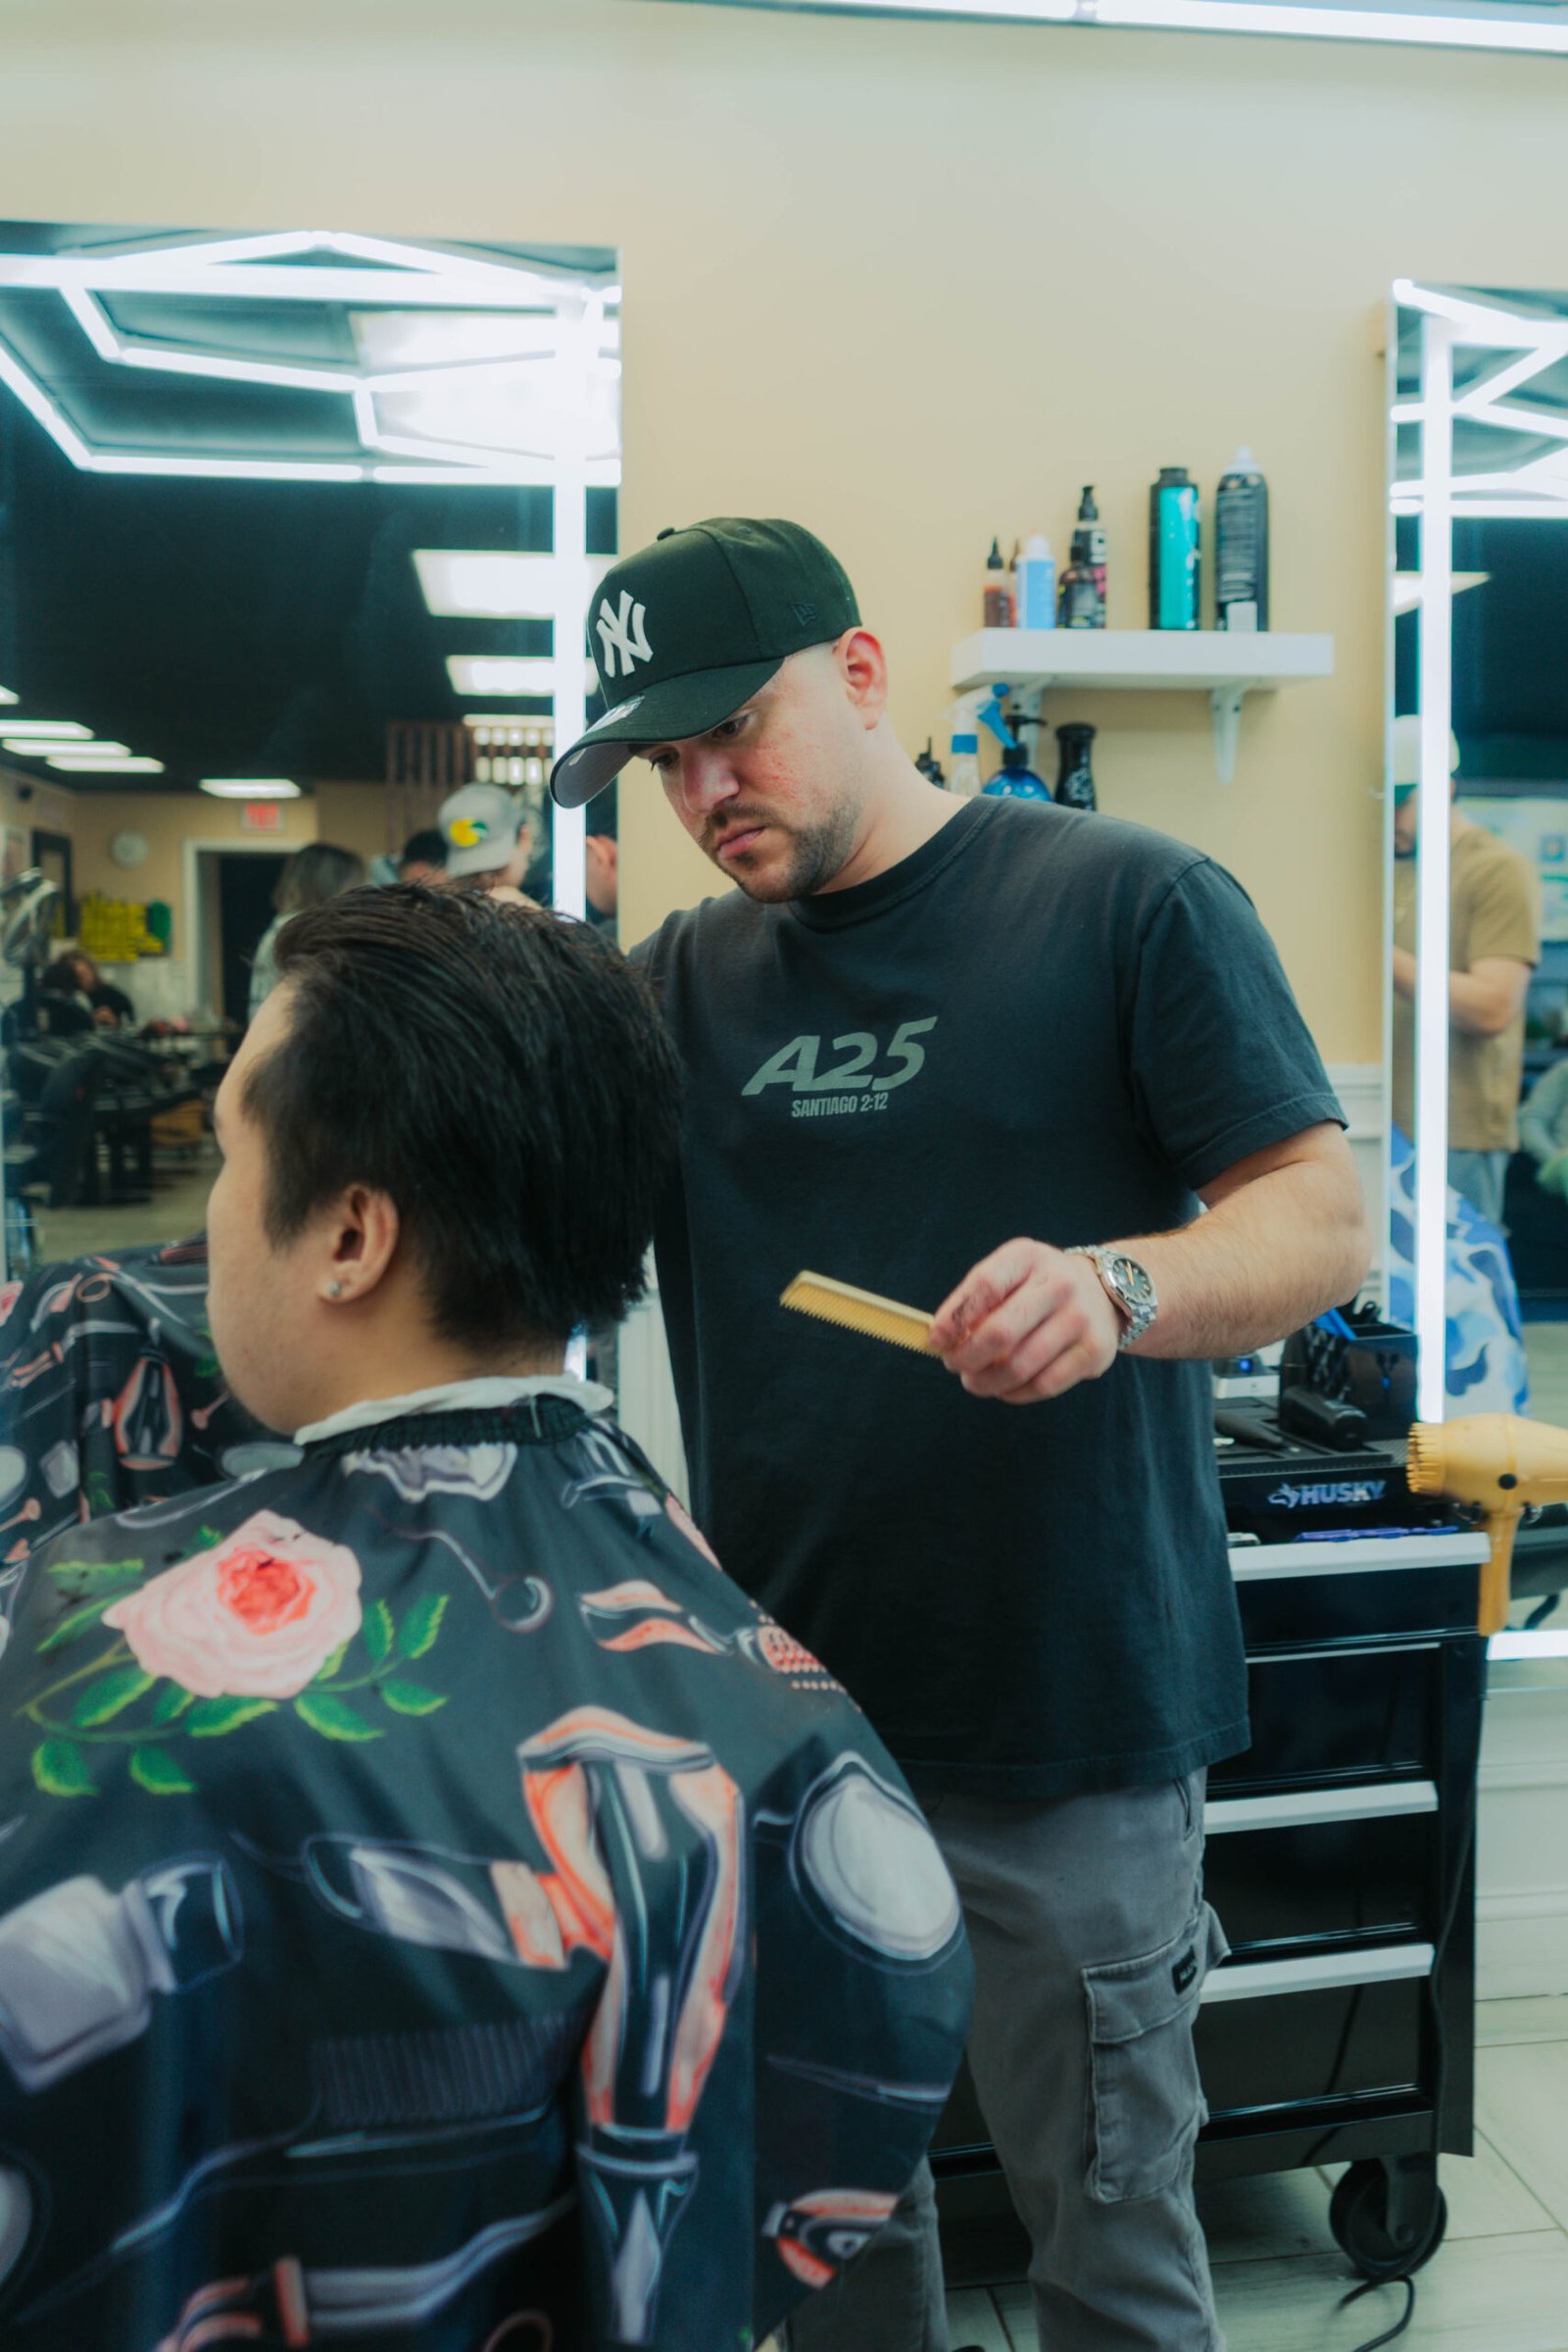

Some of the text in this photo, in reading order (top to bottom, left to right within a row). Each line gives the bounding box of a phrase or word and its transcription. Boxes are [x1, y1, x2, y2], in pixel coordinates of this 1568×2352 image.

[596, 589, 655, 678] NY
[741, 1016, 938, 1096] A25
[791, 1093, 889, 1117] SANTIAGO 2:12
[1300, 1480, 1387, 1505] HUSKY
